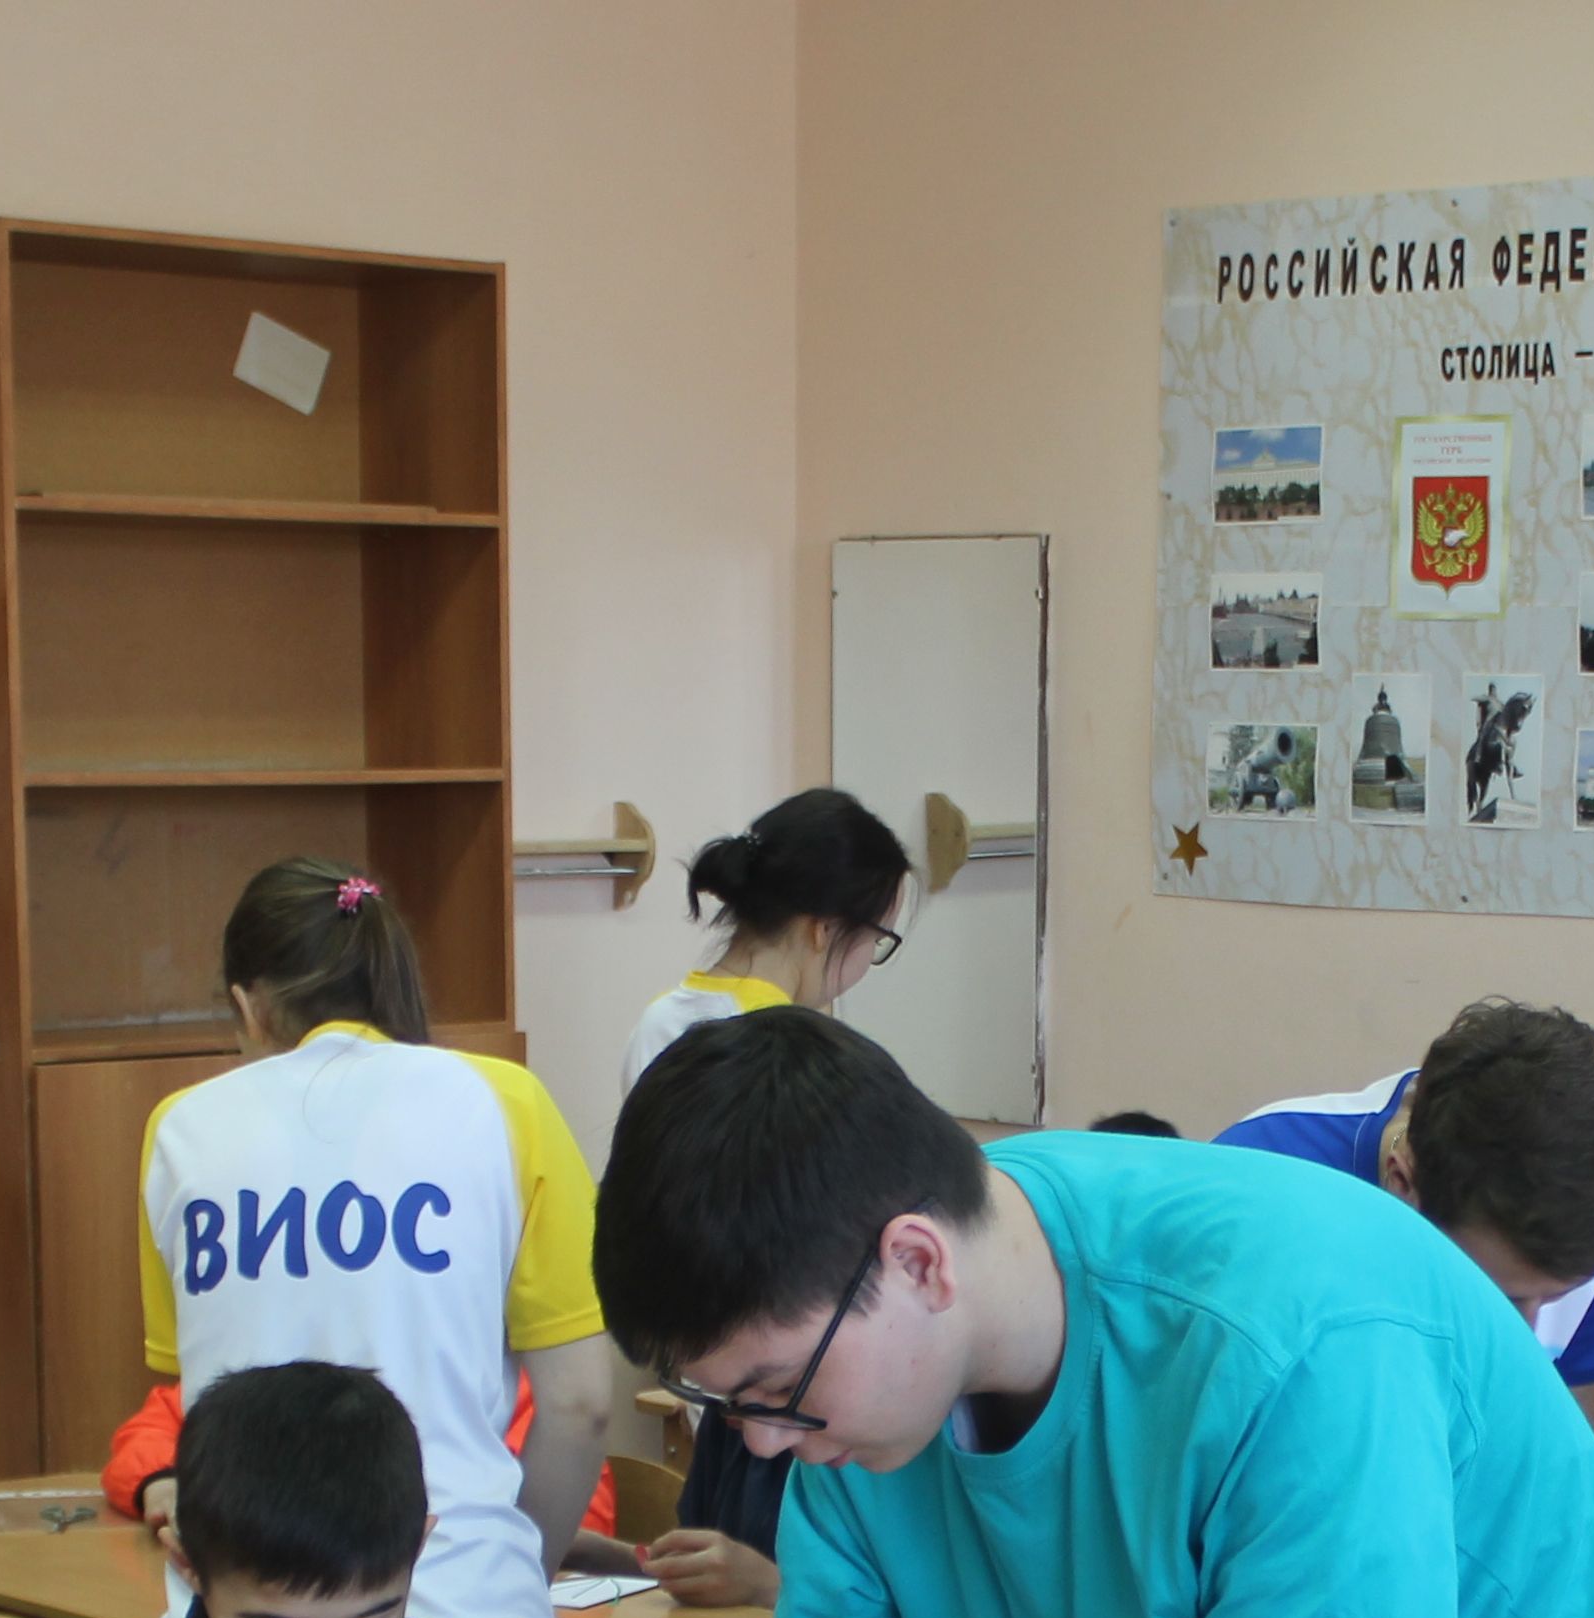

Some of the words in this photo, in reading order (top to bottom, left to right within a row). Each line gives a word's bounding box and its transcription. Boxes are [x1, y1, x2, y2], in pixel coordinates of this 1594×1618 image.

[1217, 237, 1467, 303] РОССИЙСКАЯ
[1440, 341, 1556, 384] СТОЛИЦА
[182, 1180, 452, 1296] ВИОС
